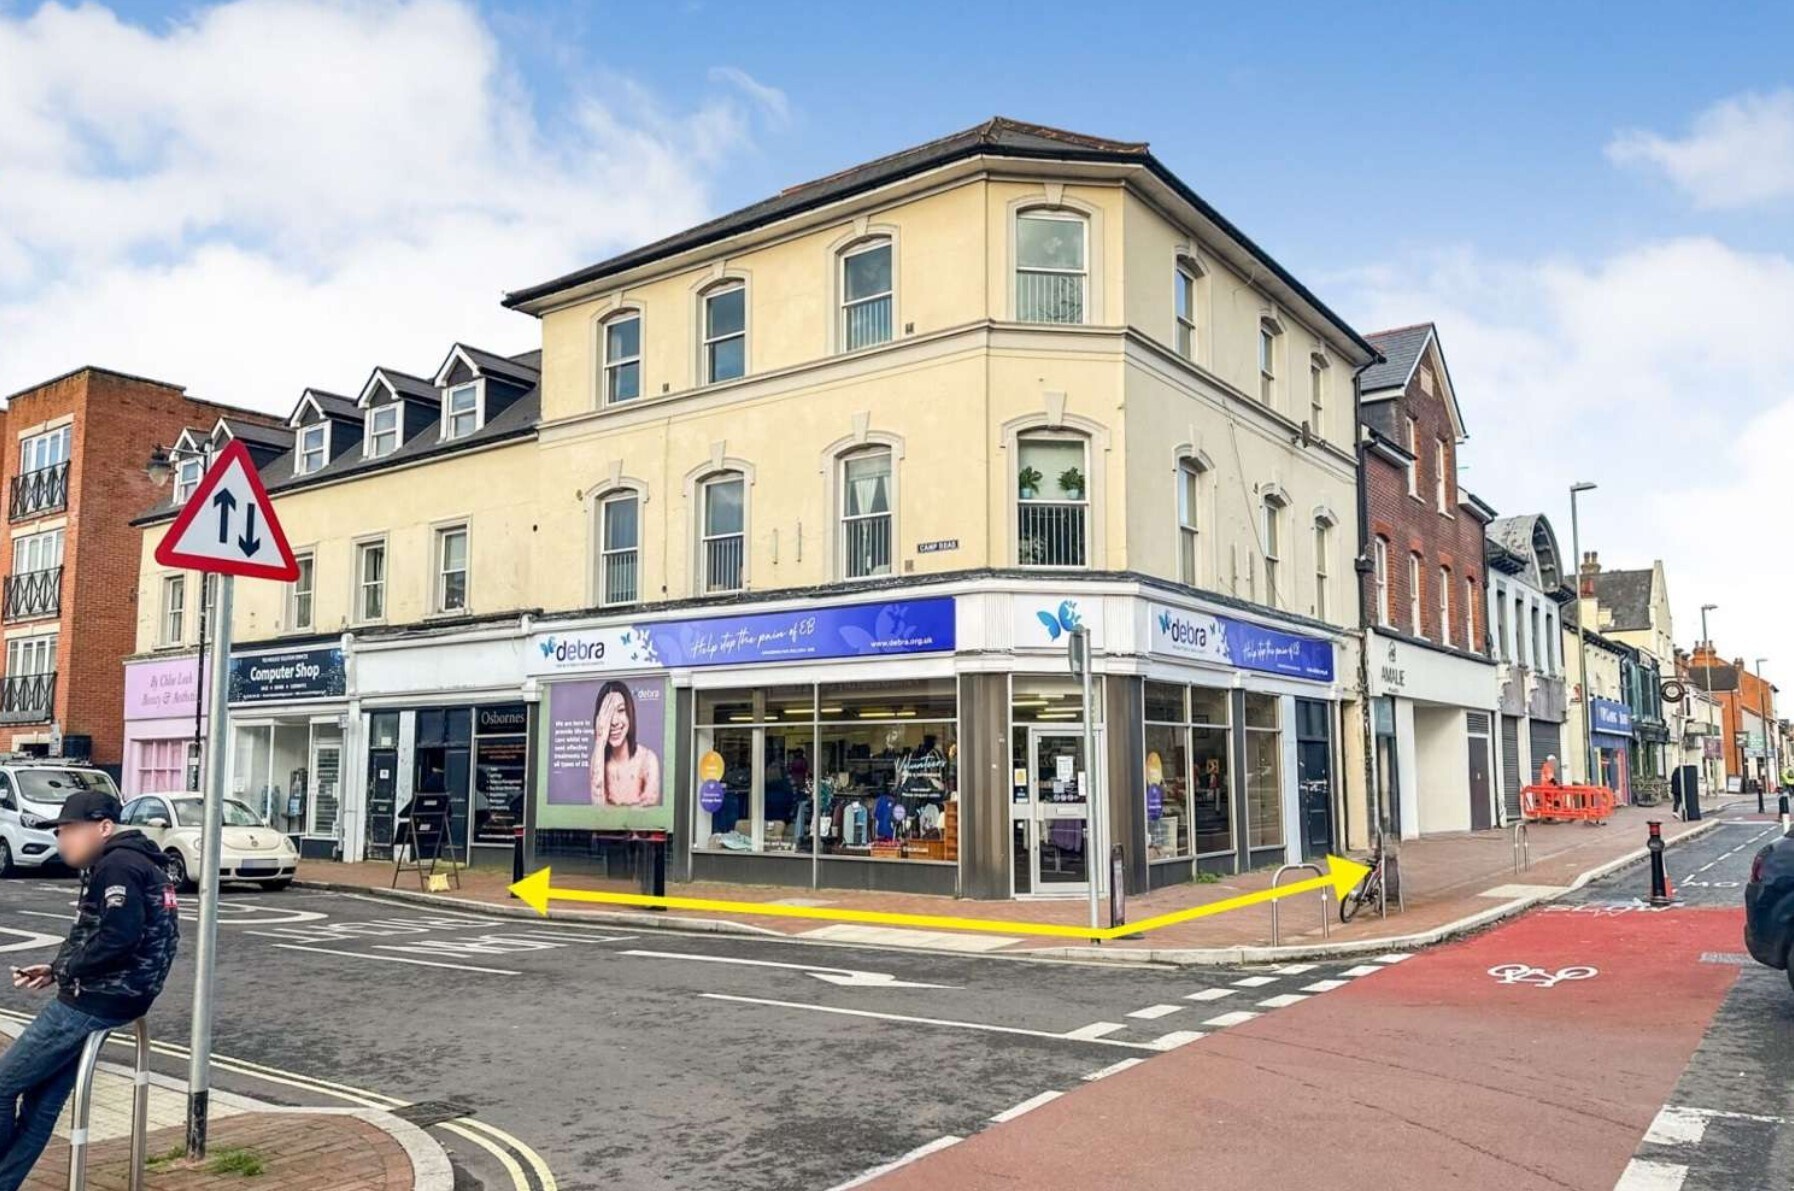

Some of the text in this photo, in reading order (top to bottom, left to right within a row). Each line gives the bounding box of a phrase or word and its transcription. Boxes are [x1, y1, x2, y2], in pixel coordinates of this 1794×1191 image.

[690, 633, 718, 660] Help
[720, 633, 736, 653] stop
[737, 627, 754, 651] the
[789, 622, 797, 642] of
[799, 617, 816, 635] EB
[870, 637, 933, 648] www.debra.org.uk
[1172, 618, 1206, 647] debra
[556, 640, 604, 661] debra
[250, 662, 320, 683] Computer Shop
[638, 689, 659, 699] debra
[481, 712, 525, 725] Osbornes
